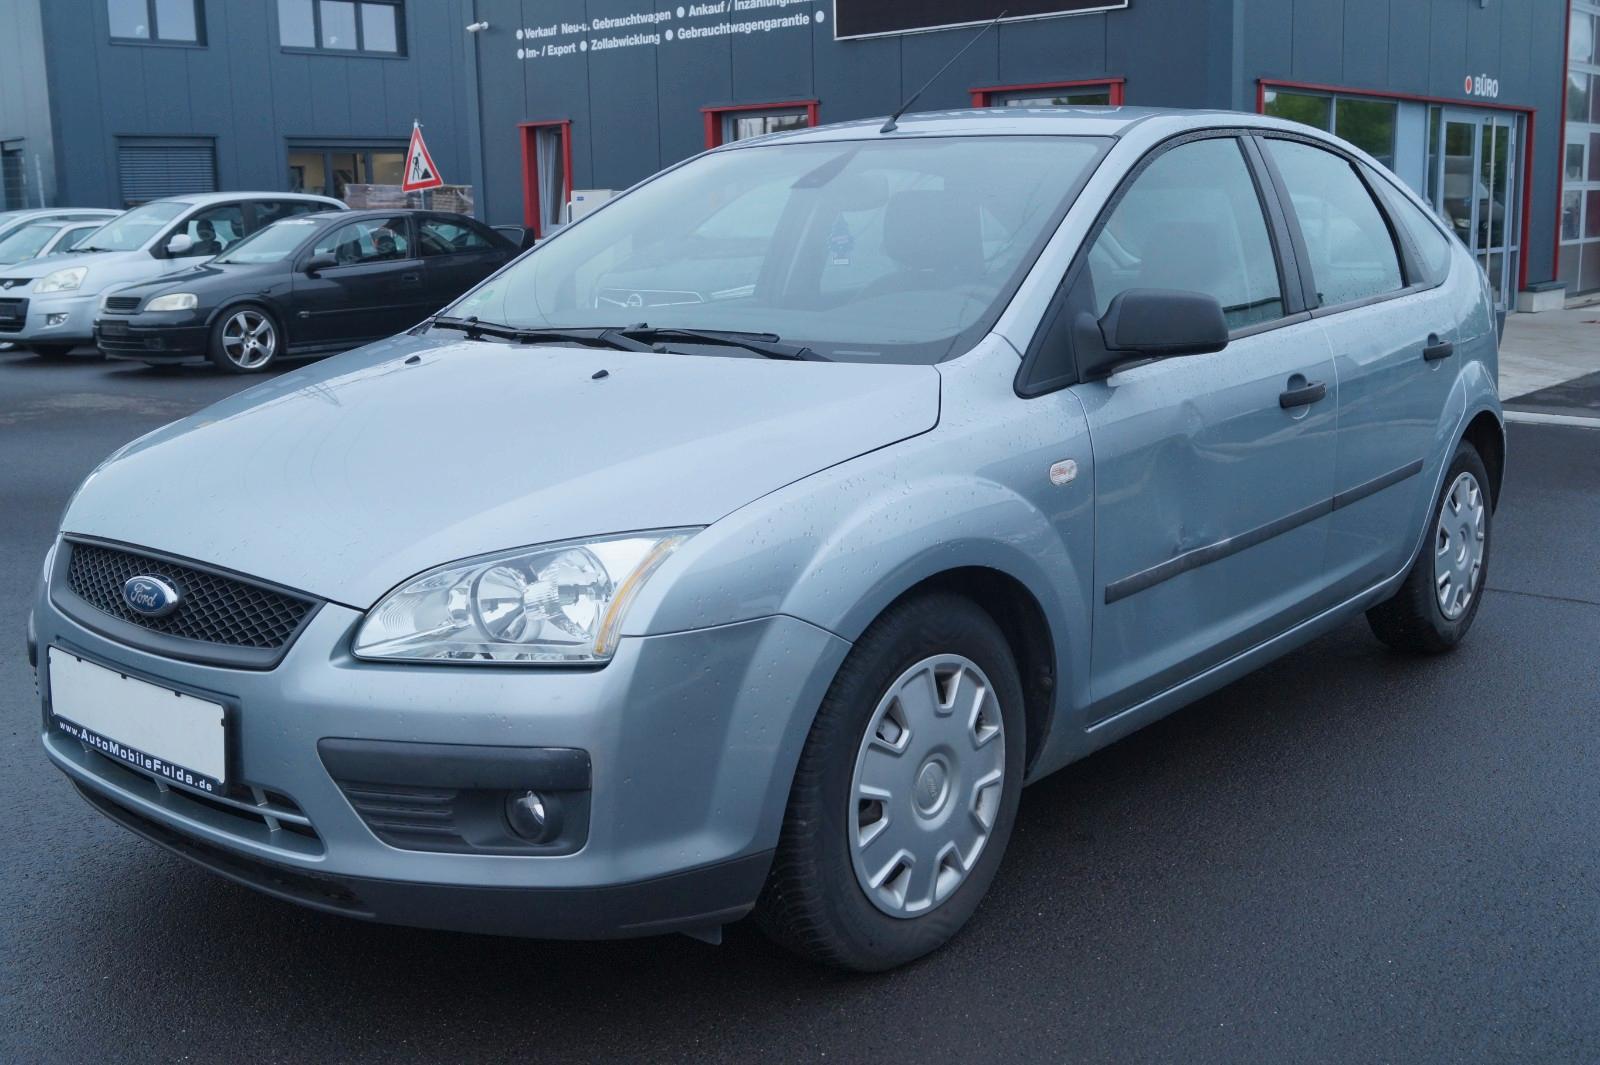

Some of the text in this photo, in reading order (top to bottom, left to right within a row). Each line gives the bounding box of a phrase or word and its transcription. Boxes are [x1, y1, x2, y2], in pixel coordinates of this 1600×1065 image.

[524, 24, 558, 39] Verkauf
[592, 10, 672, 30] Gebrauchtwagen
[688, 1, 725, 17] Ankauf
[525, 47, 540, 59] Im-
[547, 42, 577, 57] Export
[590, 33, 661, 51] Zollabwicklung
[677, 12, 810, 40] Gebrauchtwagengarantie
[1474, 73, 1499, 98] BÜRO
[130, 582, 158, 607] Ford
[59, 721, 212, 792] www.AutoMobileFulda.de
